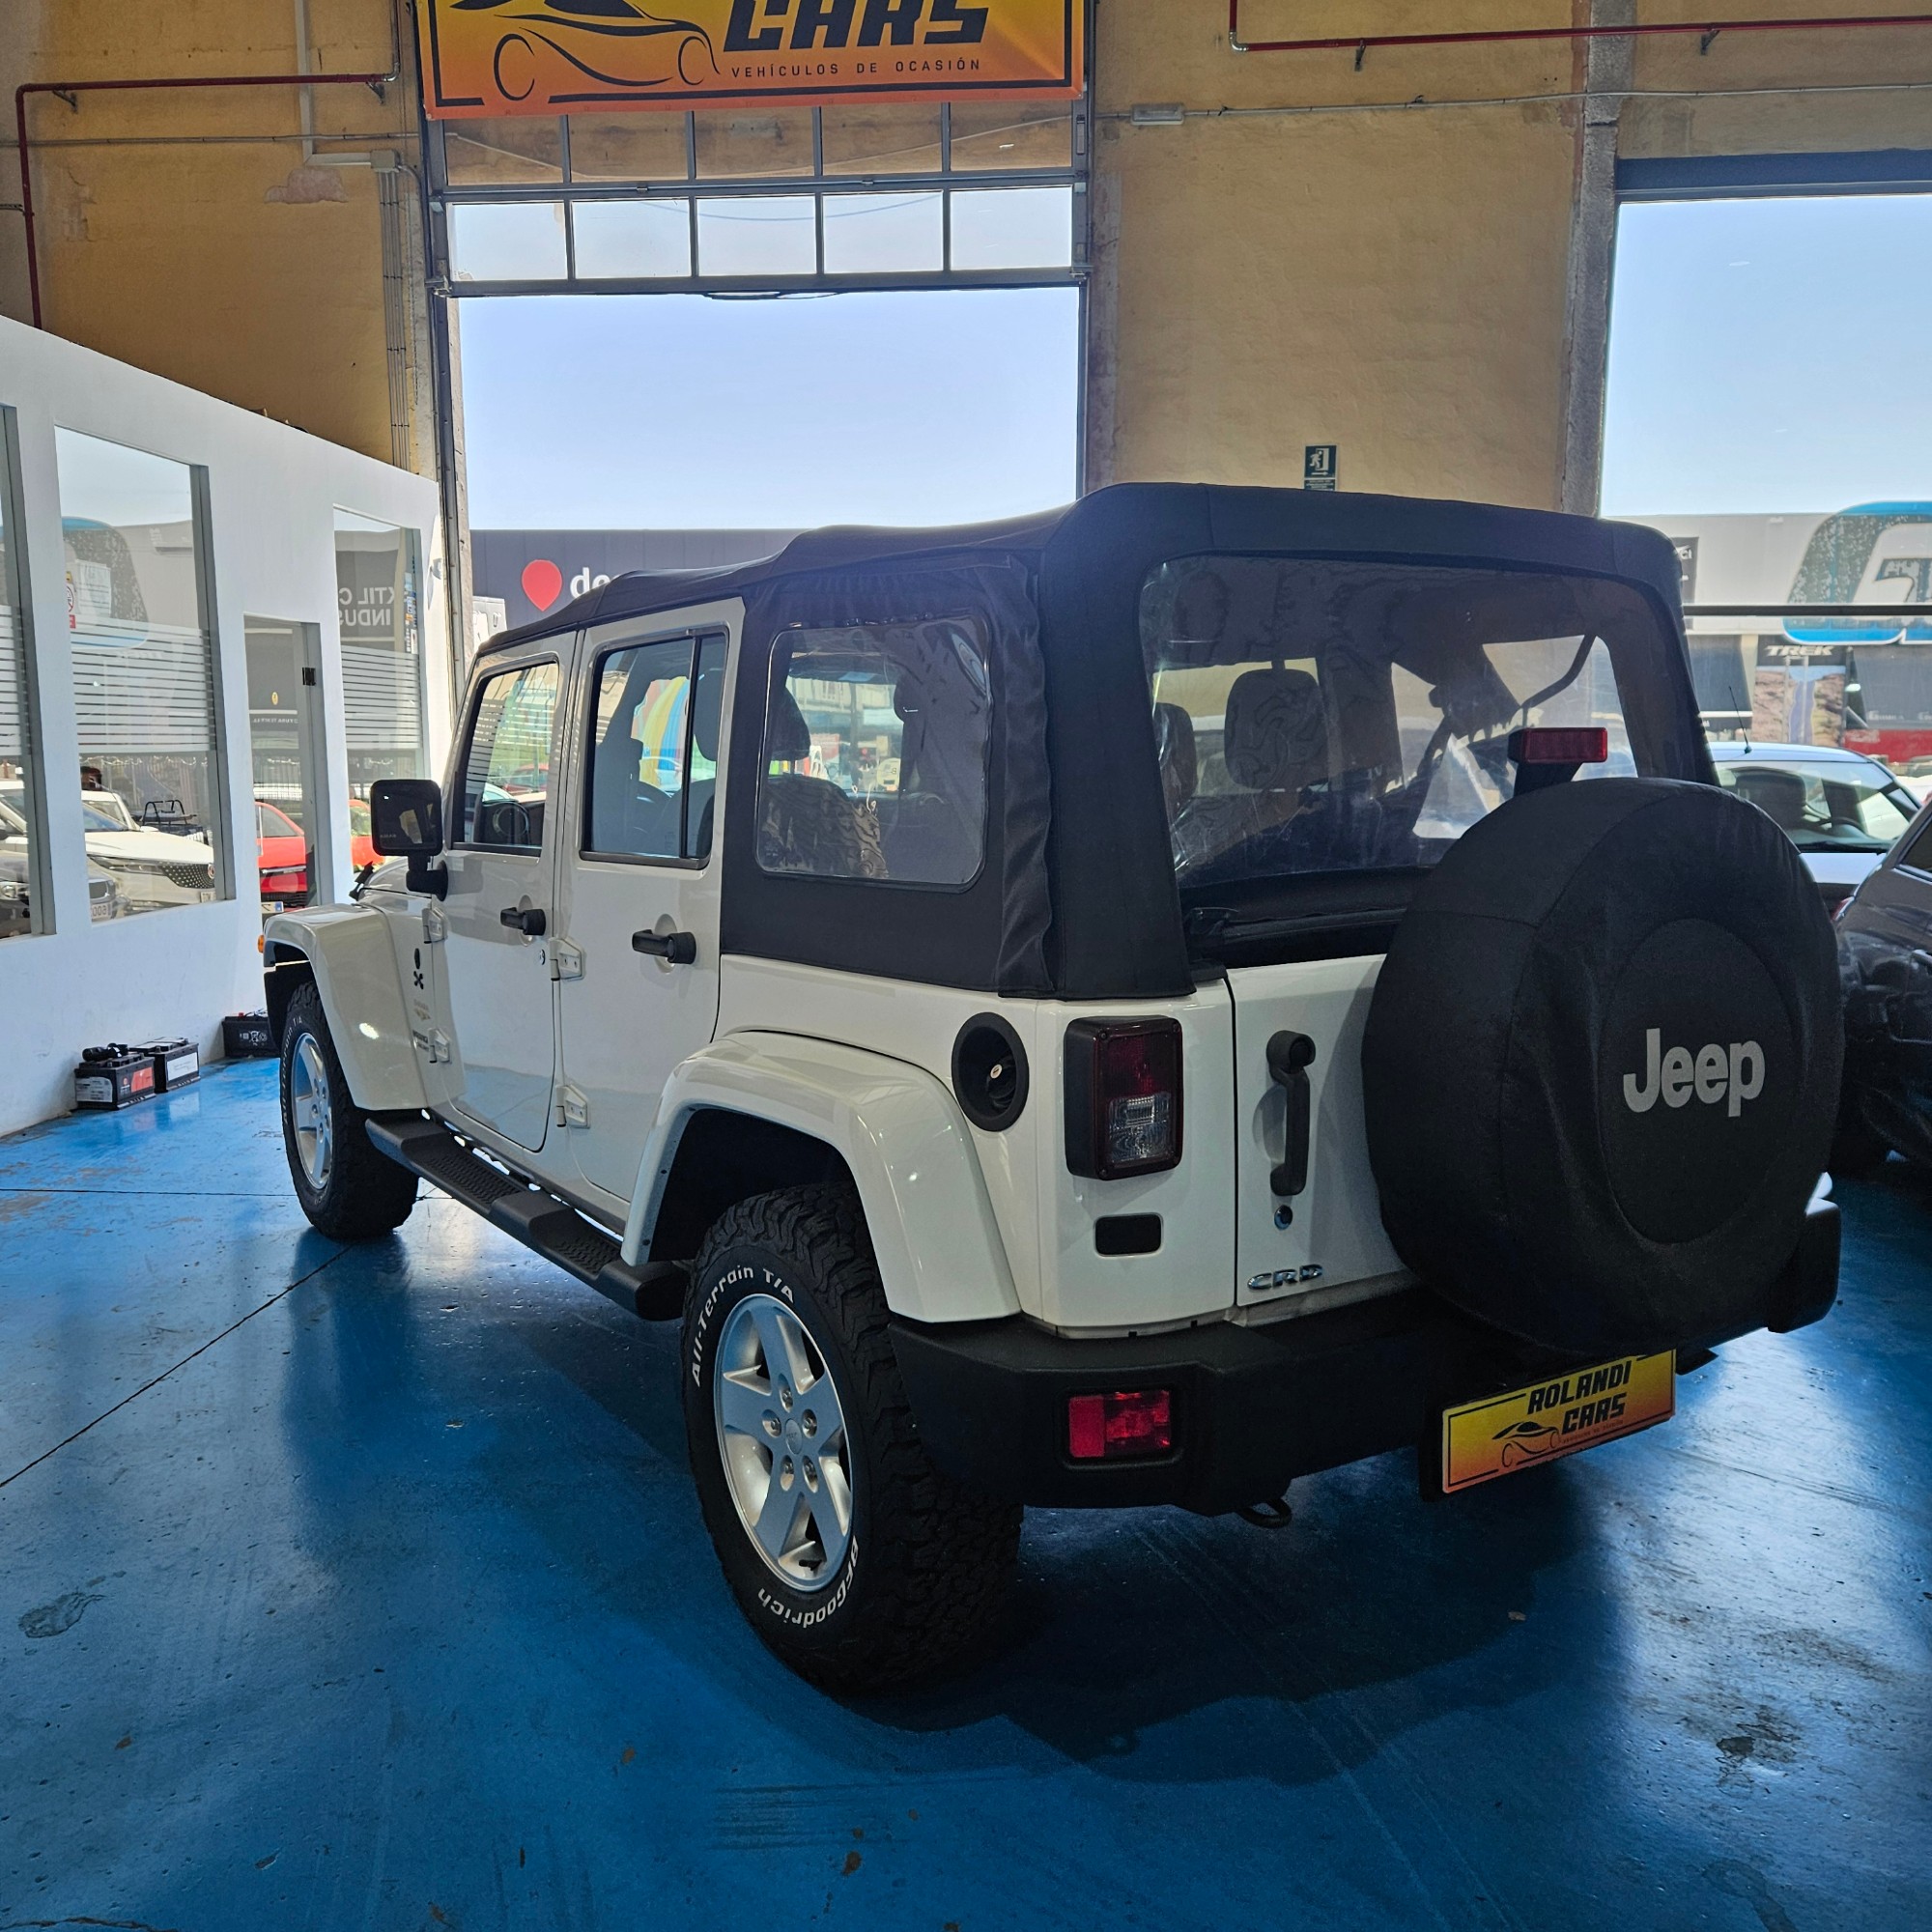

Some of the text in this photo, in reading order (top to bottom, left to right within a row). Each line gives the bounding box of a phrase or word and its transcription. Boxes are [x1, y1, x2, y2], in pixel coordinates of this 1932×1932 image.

[724, 0, 988, 52] CARS
[731, 57, 980, 78] VEHÍCULOS DE OCASIÓN
[1764, 644, 1834, 657] TREK
[1623, 1027, 1766, 1118] Jeep
[1247, 1264, 1323, 1290] CRD
[692, 1264, 754, 1387] All-Terrain
[1527, 1360, 1633, 1415] ROLANDI
[1561, 1392, 1628, 1435] CARS
[757, 1535, 859, 1629] BFGoodrich
